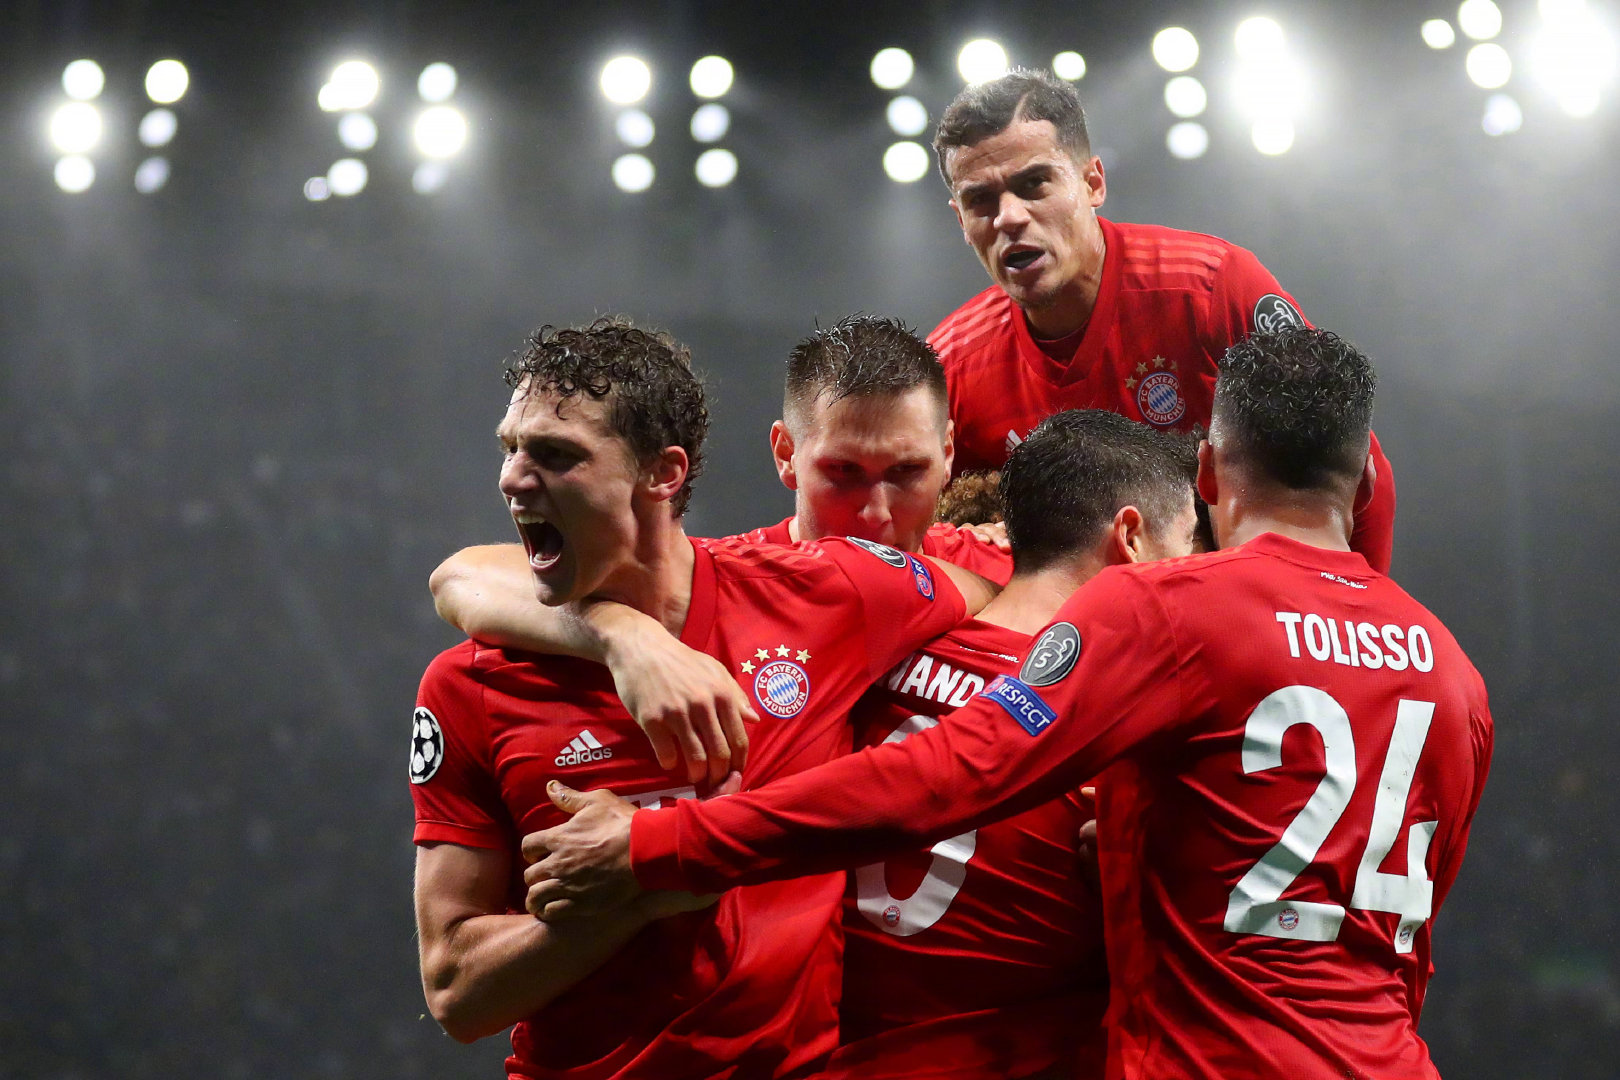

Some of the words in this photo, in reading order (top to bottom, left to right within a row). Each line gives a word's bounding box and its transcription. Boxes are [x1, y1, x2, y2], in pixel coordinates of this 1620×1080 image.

[1141, 390, 1148, 402] FC
[1145, 376, 1179, 390] BAYERN
[1275, 611, 1434, 673] TOLISSO
[1034, 652, 1052, 668] 5
[758, 676, 768, 689] FC
[766, 665, 804, 683] BAYERN
[763, 692, 807, 715] MÜNCHEN
[995, 683, 1051, 728] RESPECT
[554, 747, 613, 767] adidas
[1224, 685, 1438, 954] 24
